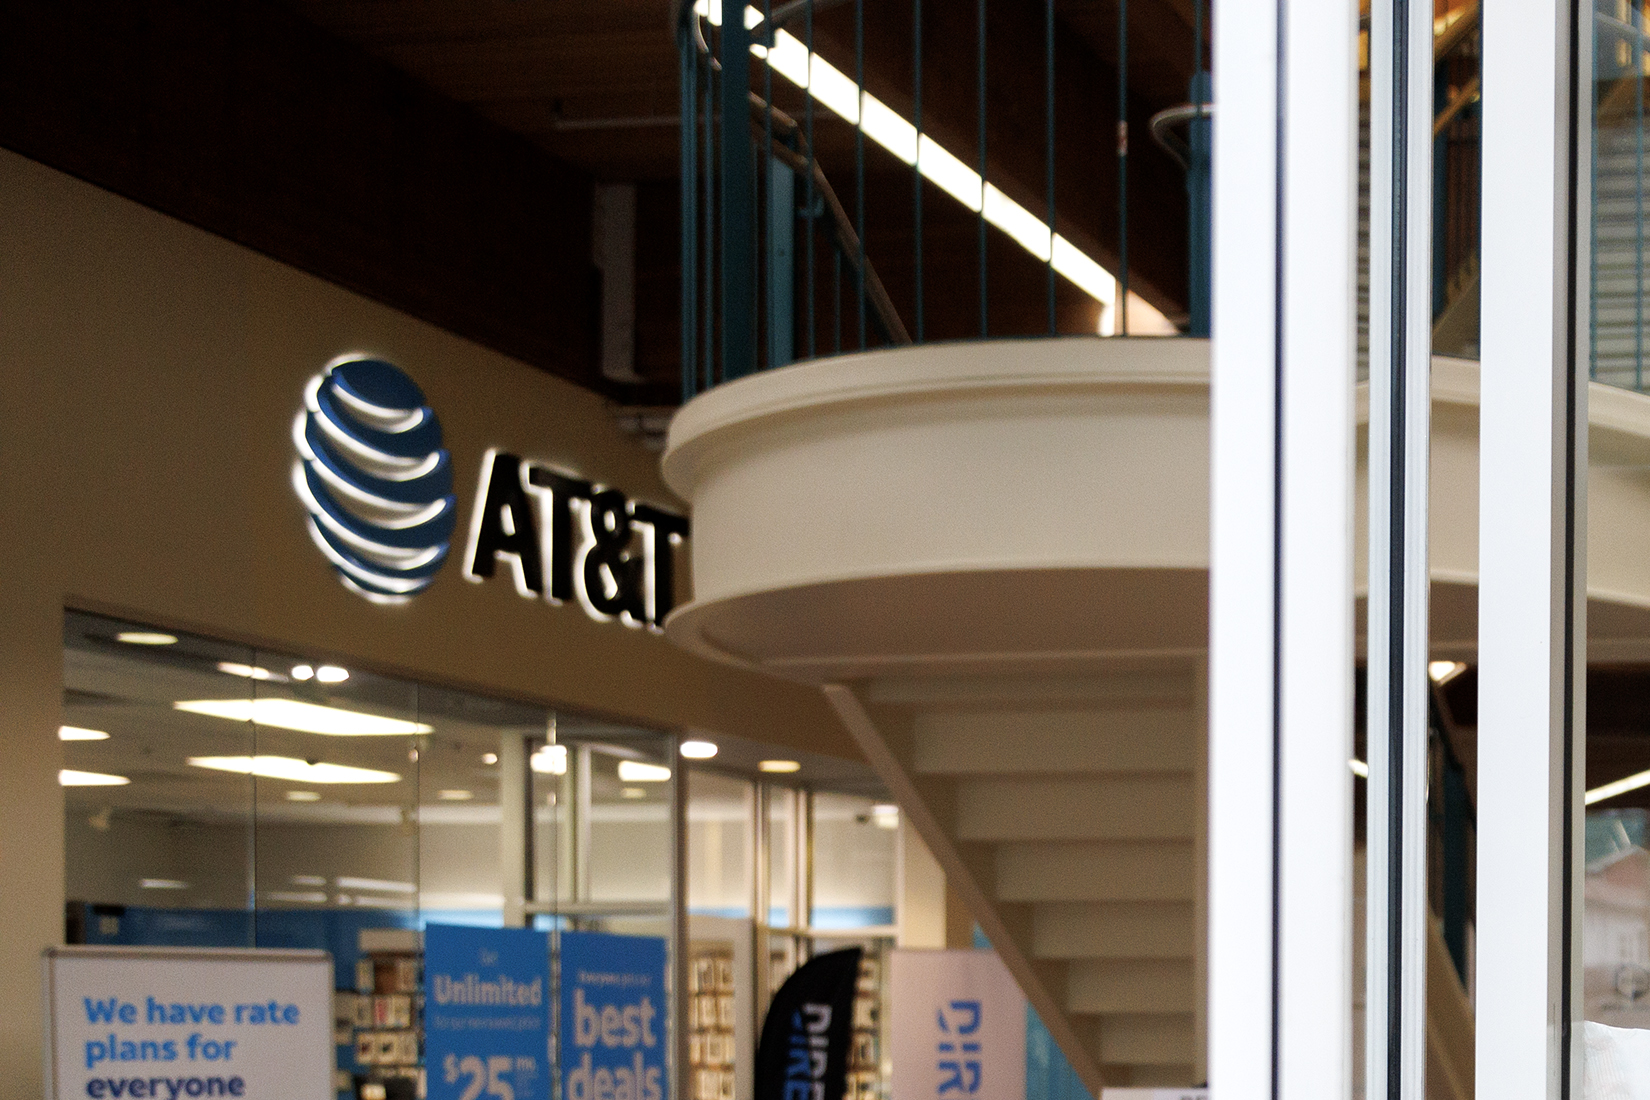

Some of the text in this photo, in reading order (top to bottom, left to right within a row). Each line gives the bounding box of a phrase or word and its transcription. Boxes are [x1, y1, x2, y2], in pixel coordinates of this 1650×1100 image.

[463, 447, 689, 635] AT&T
[433, 972, 542, 1006] Unlimited
[83, 994, 300, 1026] We have rate
[573, 987, 657, 1048] best
[85, 1032, 238, 1070] plans for
